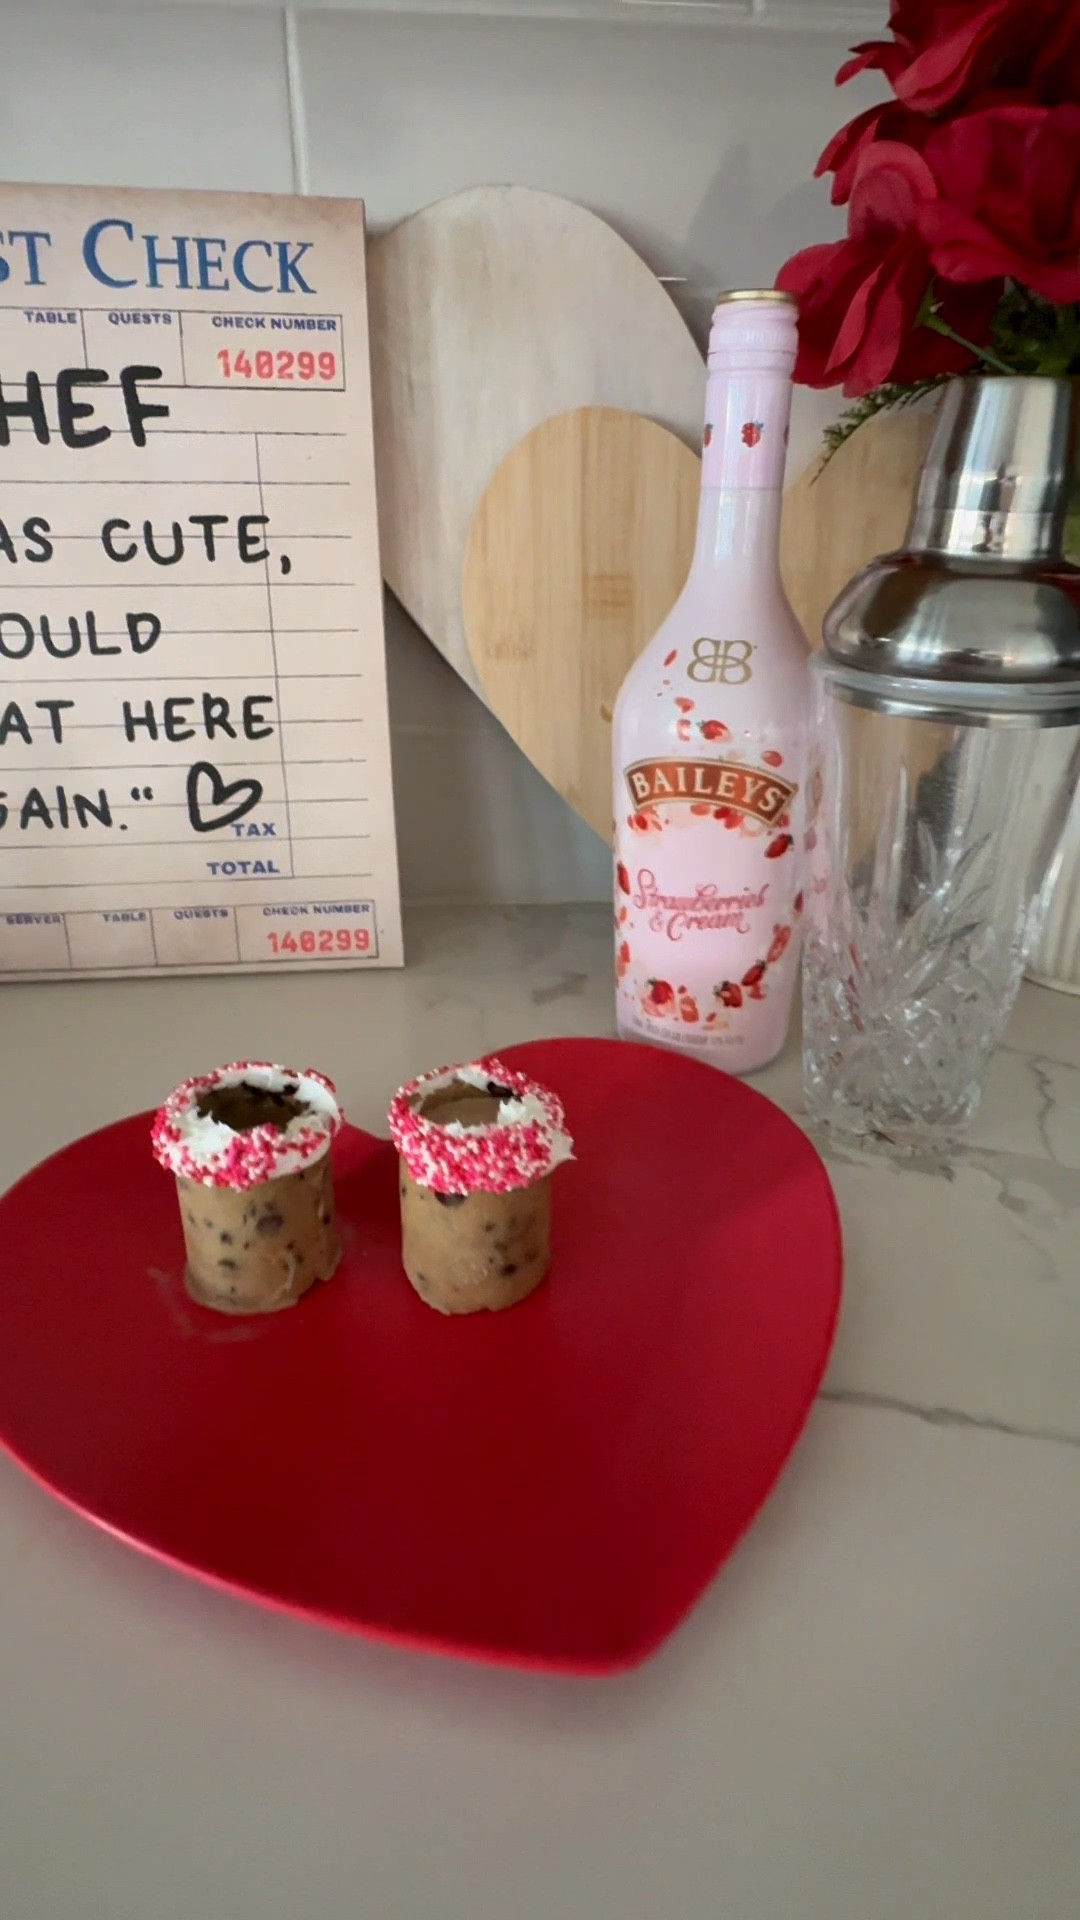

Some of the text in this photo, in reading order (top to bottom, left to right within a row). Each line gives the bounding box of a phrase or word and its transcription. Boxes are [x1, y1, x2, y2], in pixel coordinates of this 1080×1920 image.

[82, 218, 318, 294] CHECK
[25, 311, 77, 325] TABLE
[108, 313, 172, 326] QUESTS
[212, 316, 337, 332] CHECK NUMBER
[216, 349, 337, 381] 140299
[101, 514, 291, 575] CUTE,
[122, 692, 274, 743] HERE
[631, 767, 783, 812] BAILEYS
[231, 823, 277, 837] TAX
[206, 860, 280, 876] TOTAL
[102, 911, 147, 922] TABLE
[262, 903, 371, 918] CHECK NUMBER
[266, 928, 371, 954] 140299
